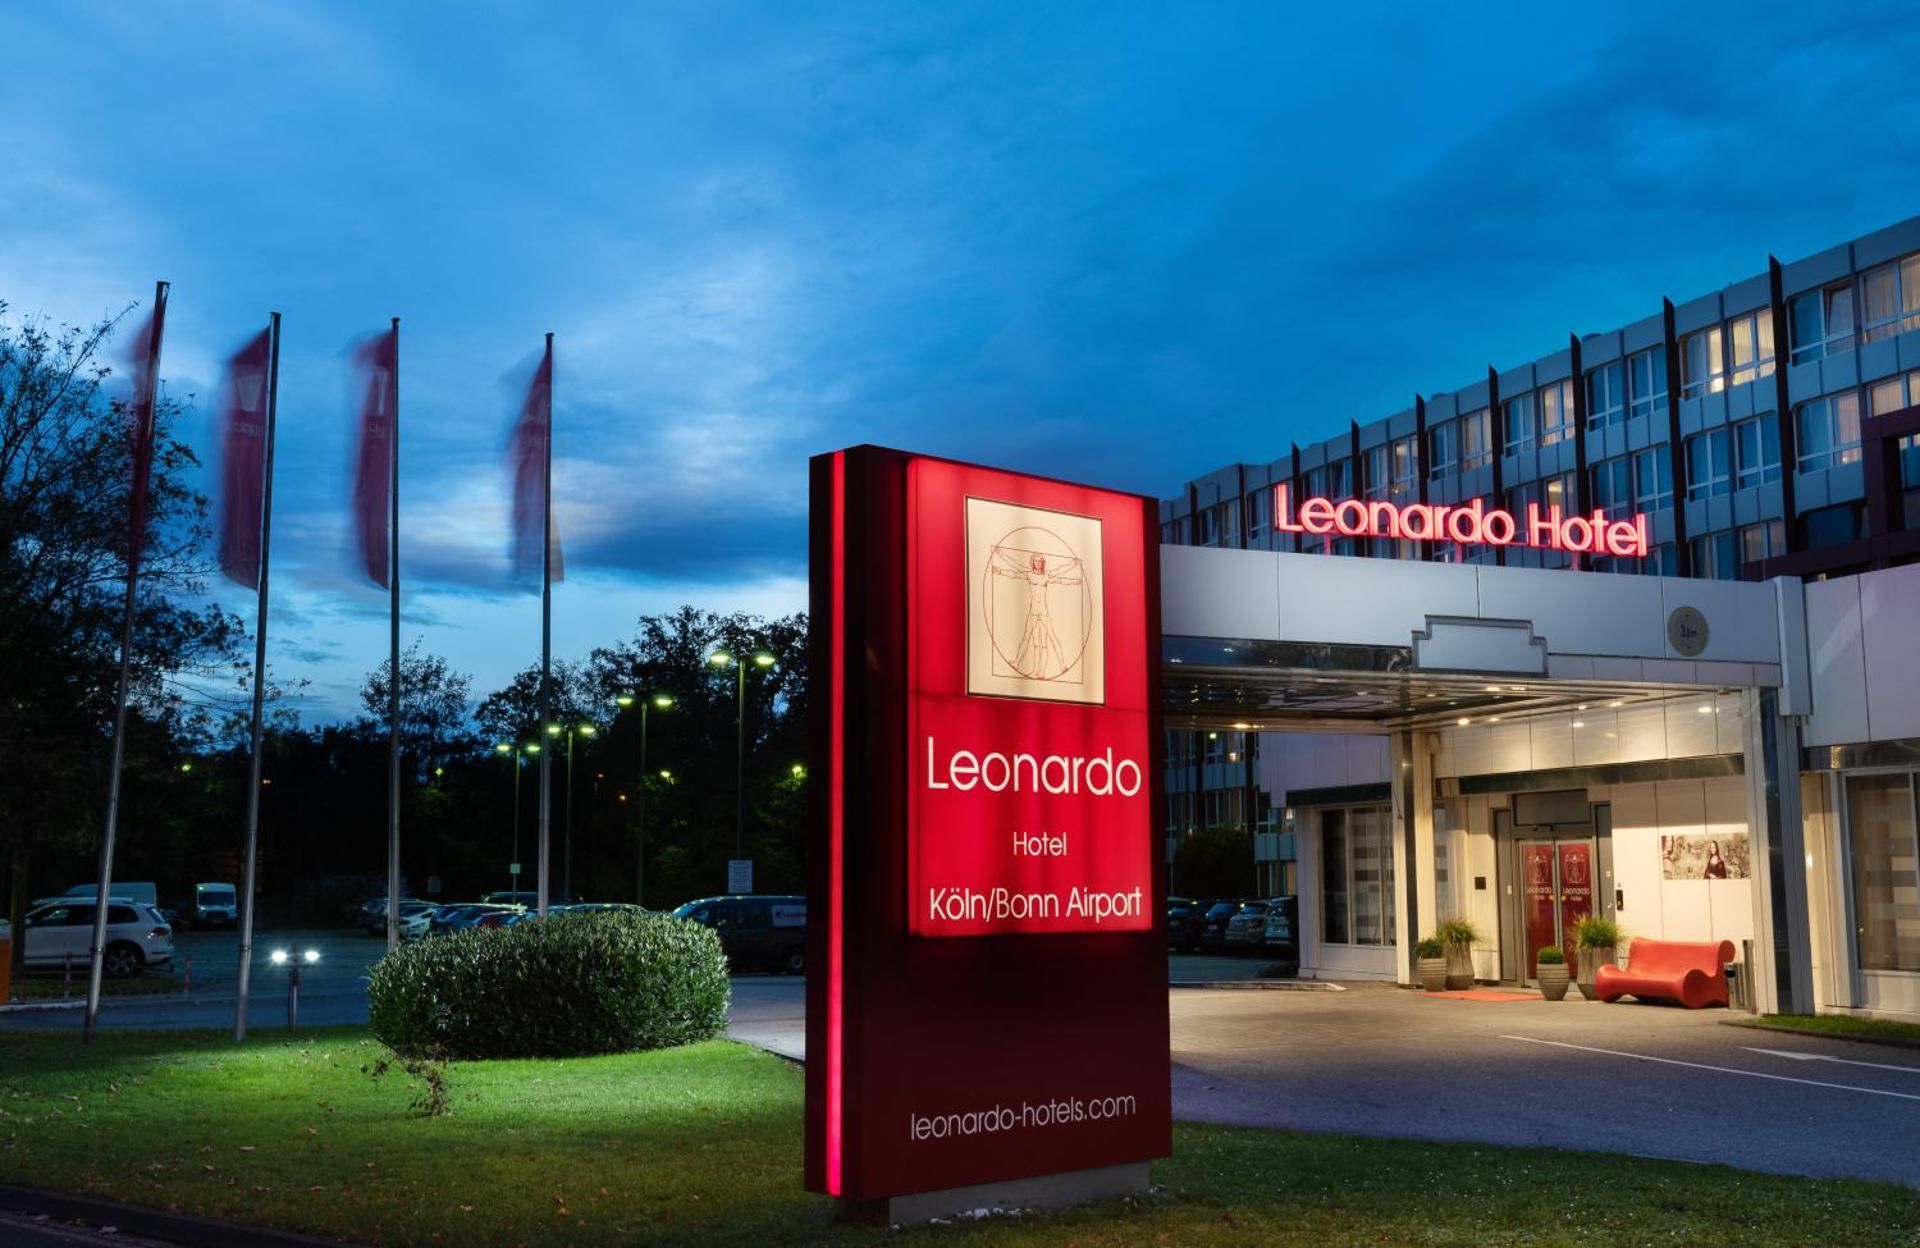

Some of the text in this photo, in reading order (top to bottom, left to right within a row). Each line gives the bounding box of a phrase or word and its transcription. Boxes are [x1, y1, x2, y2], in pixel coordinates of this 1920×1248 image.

[1274, 484, 1647, 557] Leonardo Hotel
[928, 736, 1142, 797] Leonardo
[1013, 831, 1067, 856] Hotel
[930, 886, 1142, 924] Köln/Bonn Airport
[911, 1095, 1136, 1141] leonardo-hotels.com
